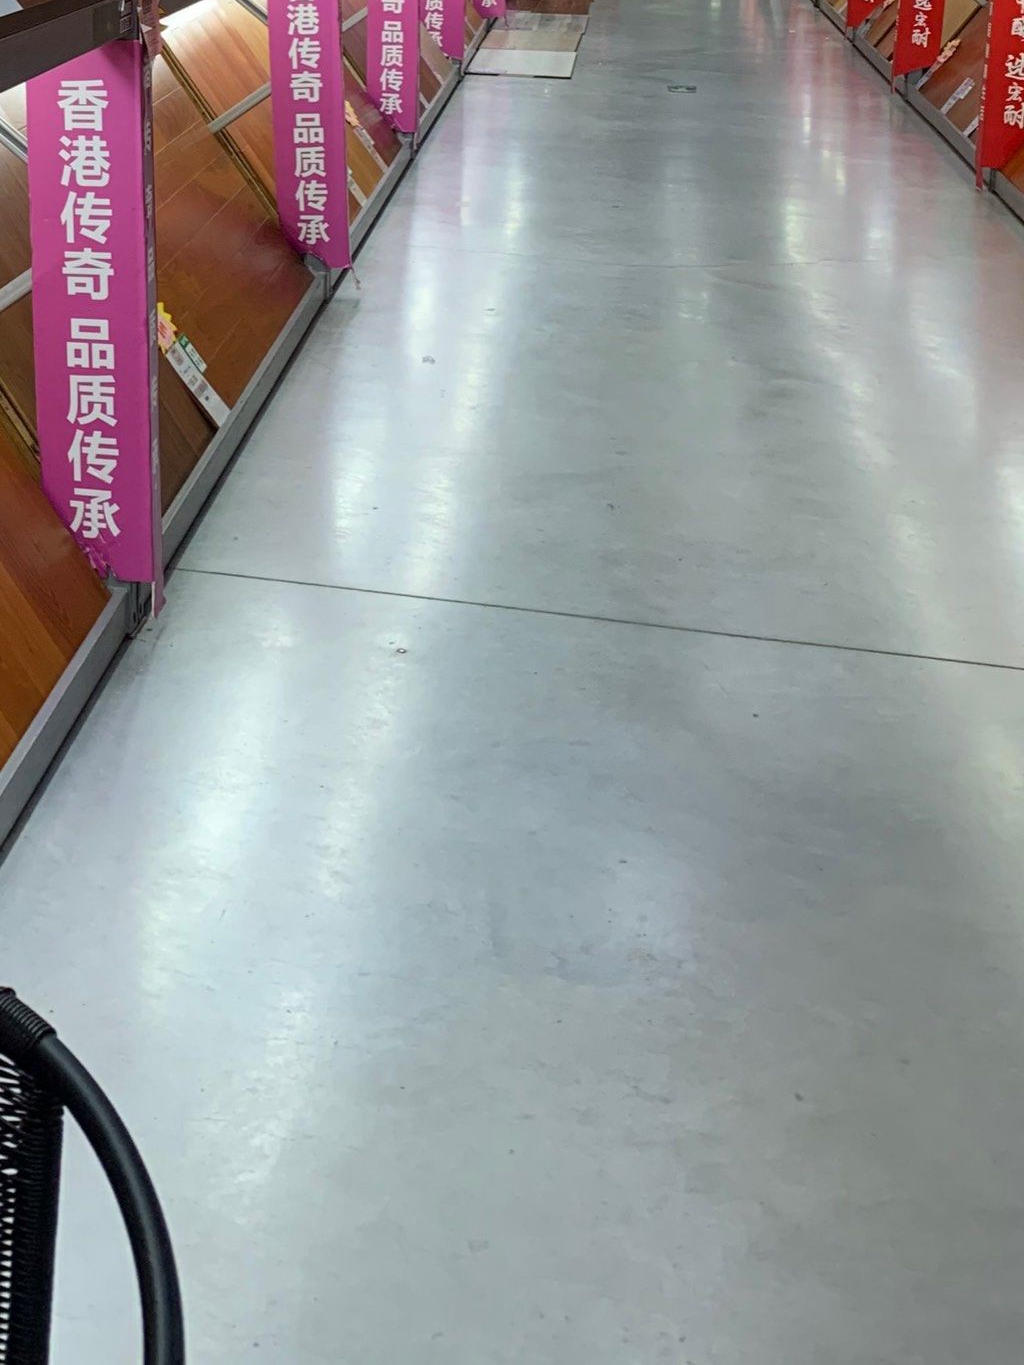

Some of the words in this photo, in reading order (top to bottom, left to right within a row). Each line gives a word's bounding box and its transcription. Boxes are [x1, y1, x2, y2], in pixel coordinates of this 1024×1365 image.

[379, 20, 405, 115] 品质传承
[57, 79, 114, 301] 香港传奇
[292, 113, 330, 246] 品质传承
[66, 318, 121, 539] 品质传承
